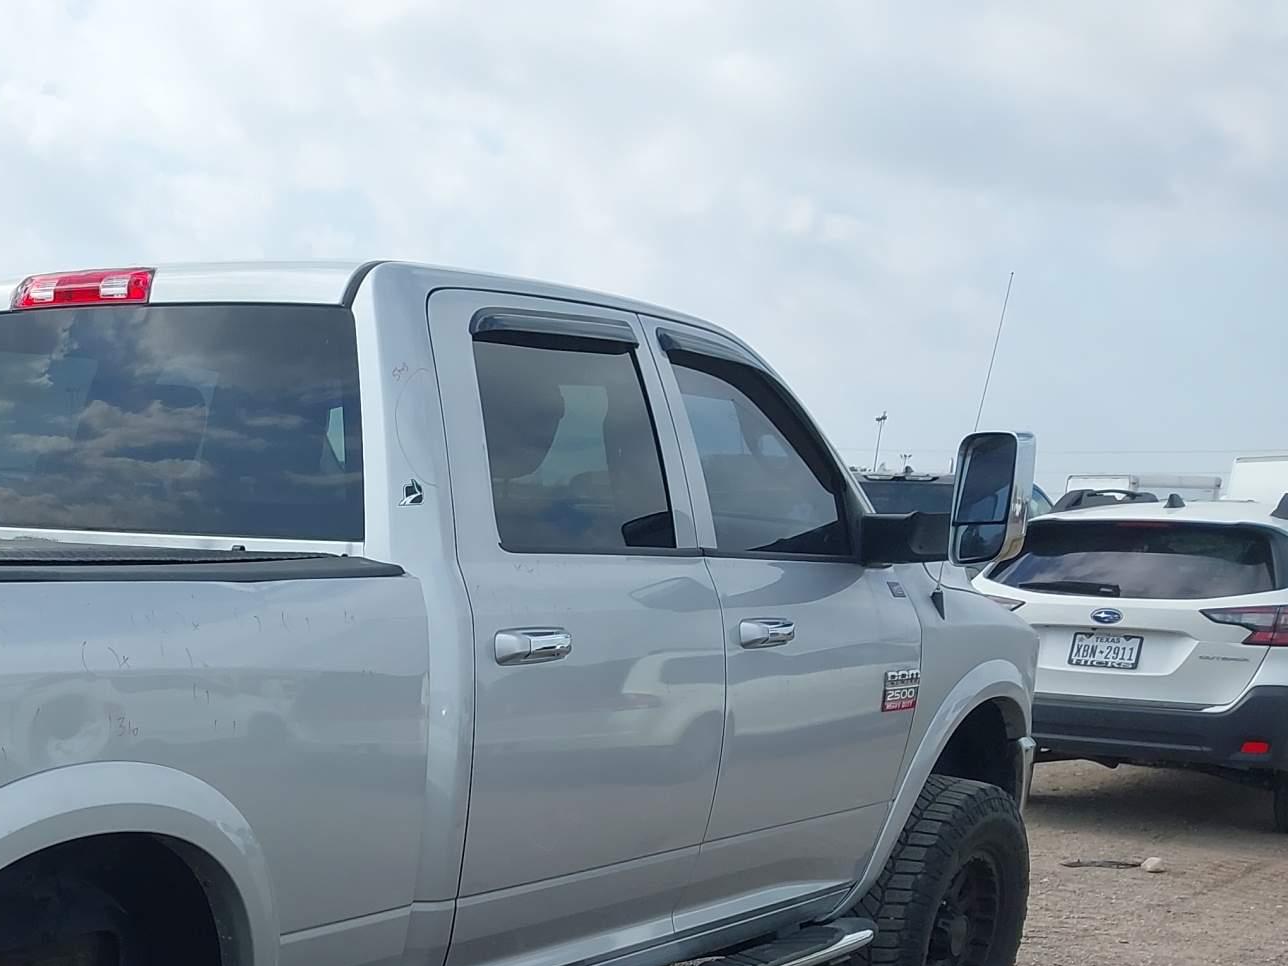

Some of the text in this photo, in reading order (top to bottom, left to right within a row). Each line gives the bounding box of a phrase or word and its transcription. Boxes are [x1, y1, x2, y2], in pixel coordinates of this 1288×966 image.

[1095, 636, 1121, 644] TEXAS
[887, 670, 921, 681] RAM
[887, 688, 915, 701] 2500
